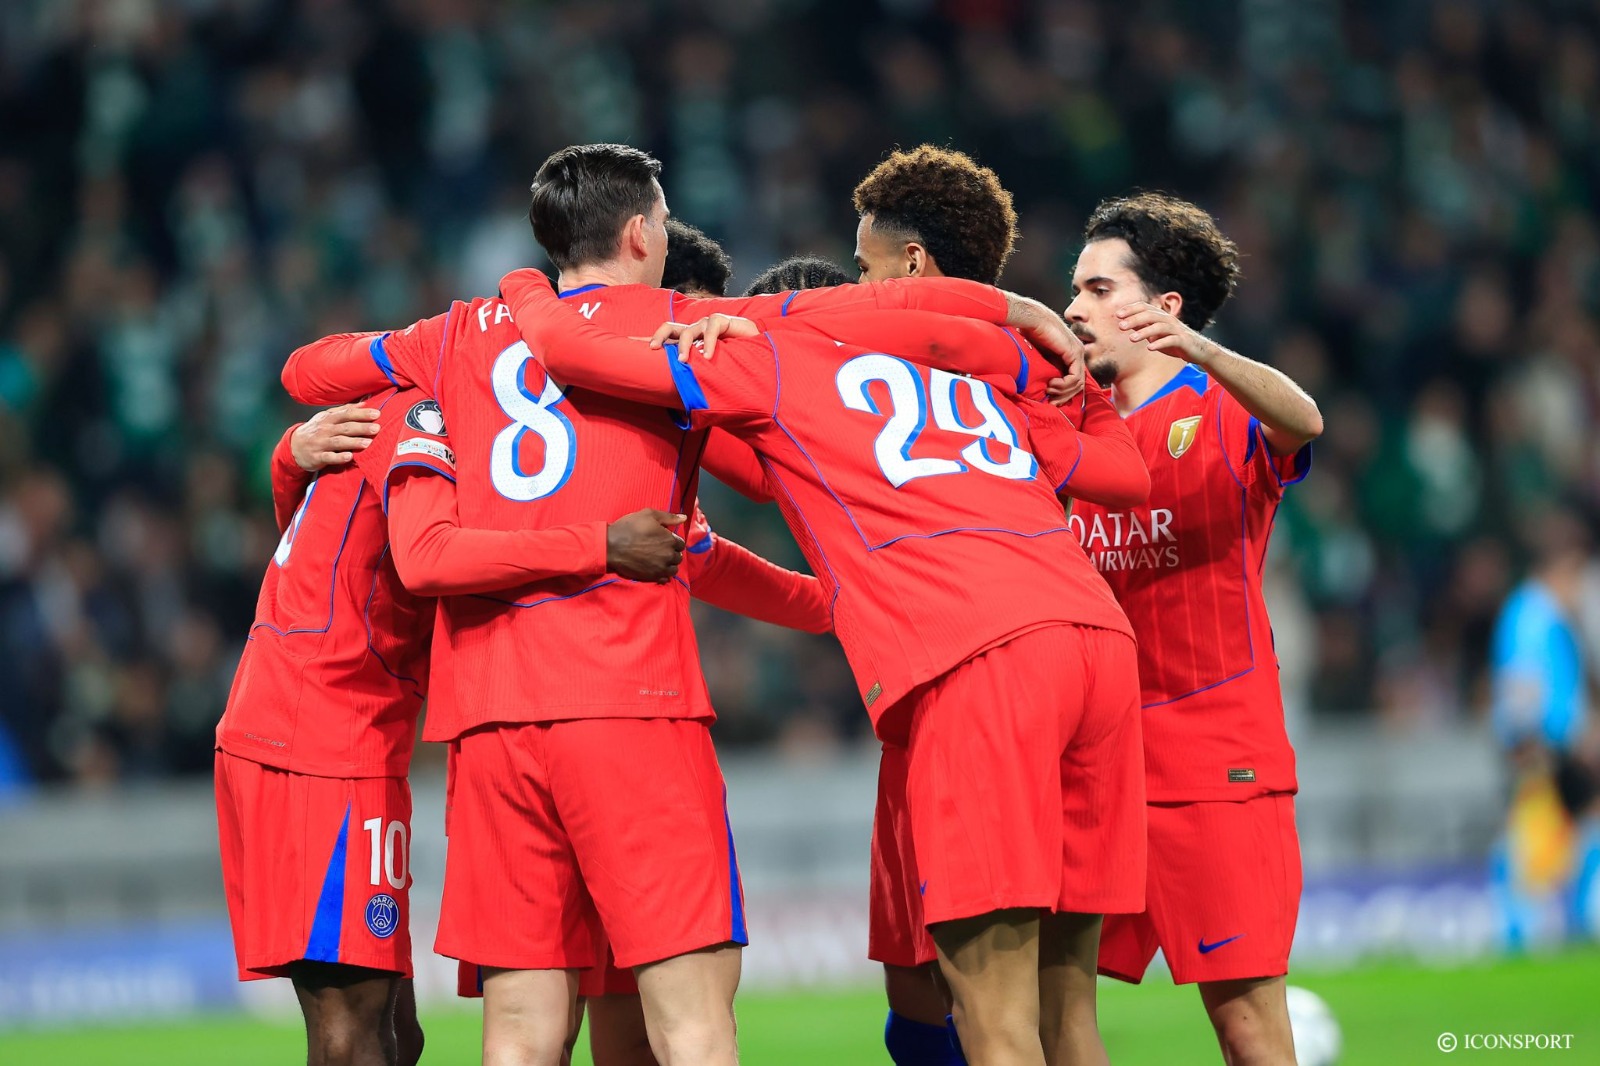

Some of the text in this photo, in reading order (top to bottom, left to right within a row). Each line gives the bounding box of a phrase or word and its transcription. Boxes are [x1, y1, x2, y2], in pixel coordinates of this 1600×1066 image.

[477, 300, 602, 333] FAN
[490, 339, 577, 502] 8
[835, 353, 1039, 489] 29
[363, 817, 407, 890] 10
[371, 896, 395, 909] PARIS
